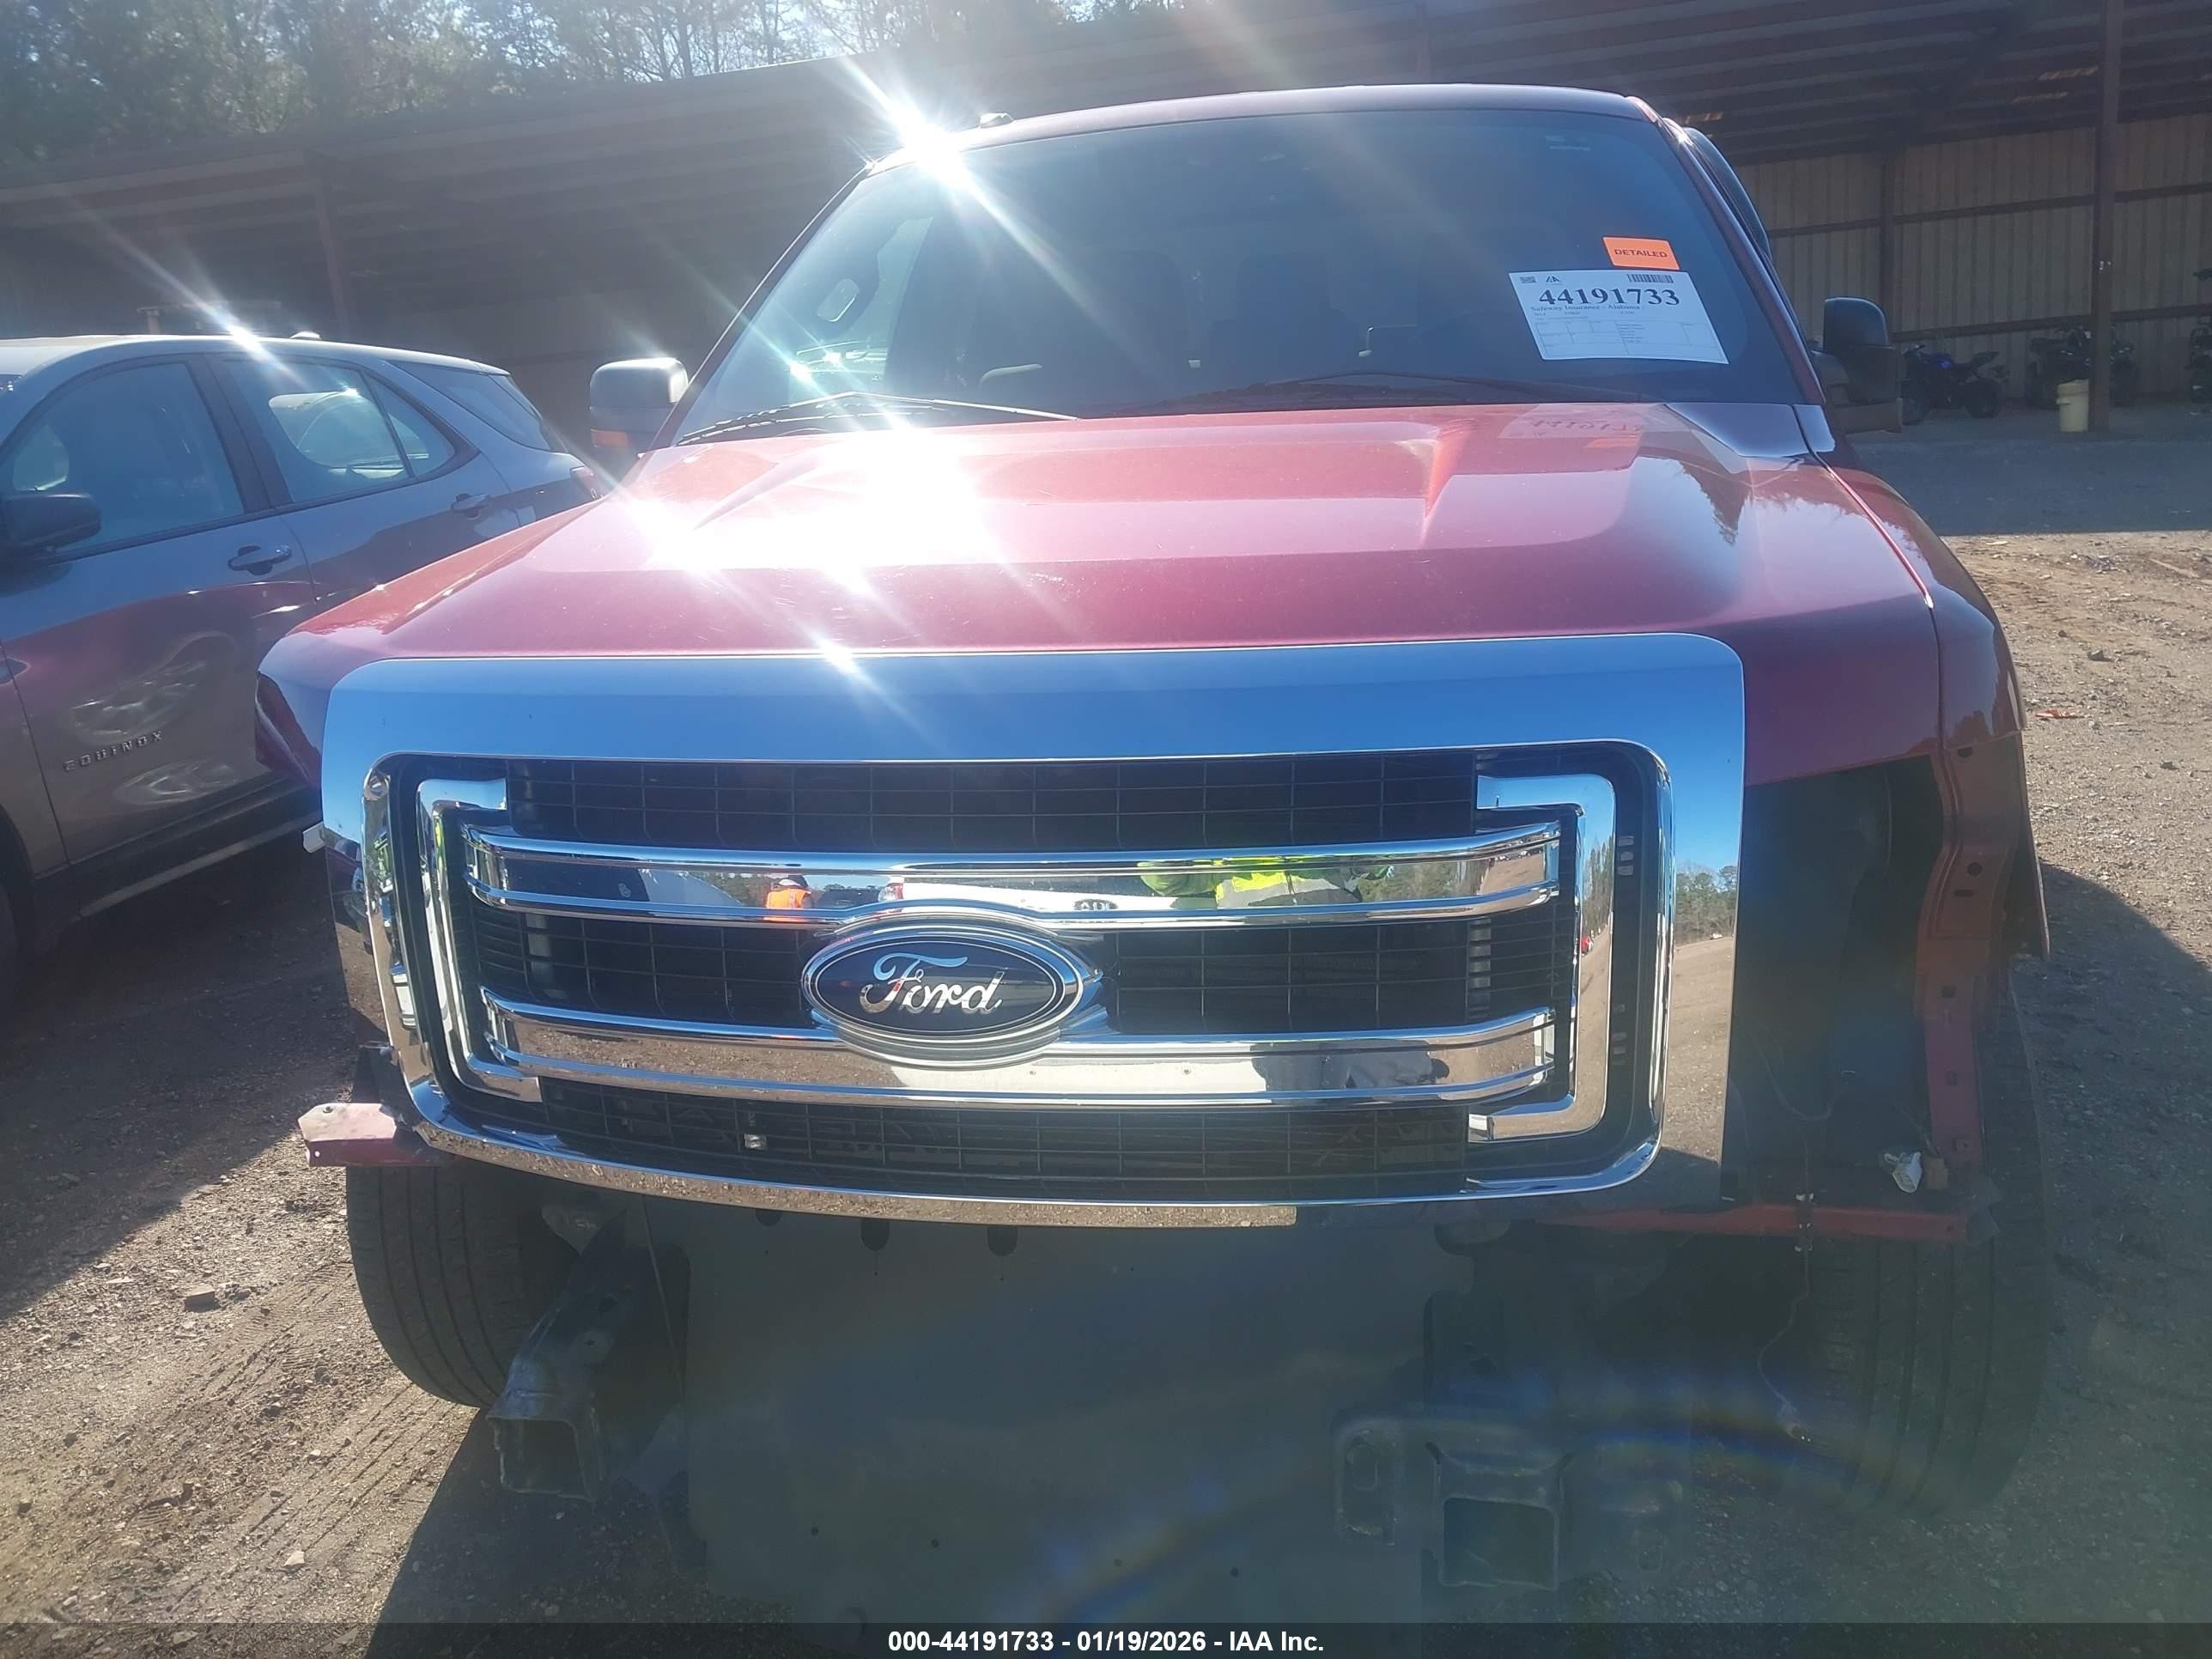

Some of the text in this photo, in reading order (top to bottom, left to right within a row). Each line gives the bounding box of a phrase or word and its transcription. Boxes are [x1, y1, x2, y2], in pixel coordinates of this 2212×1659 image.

[1613, 248, 1668, 258] DETAILED
[1539, 288, 1680, 306] 44191733
[63, 730, 163, 771] EQUINOX
[860, 951, 1006, 1015] Ford
